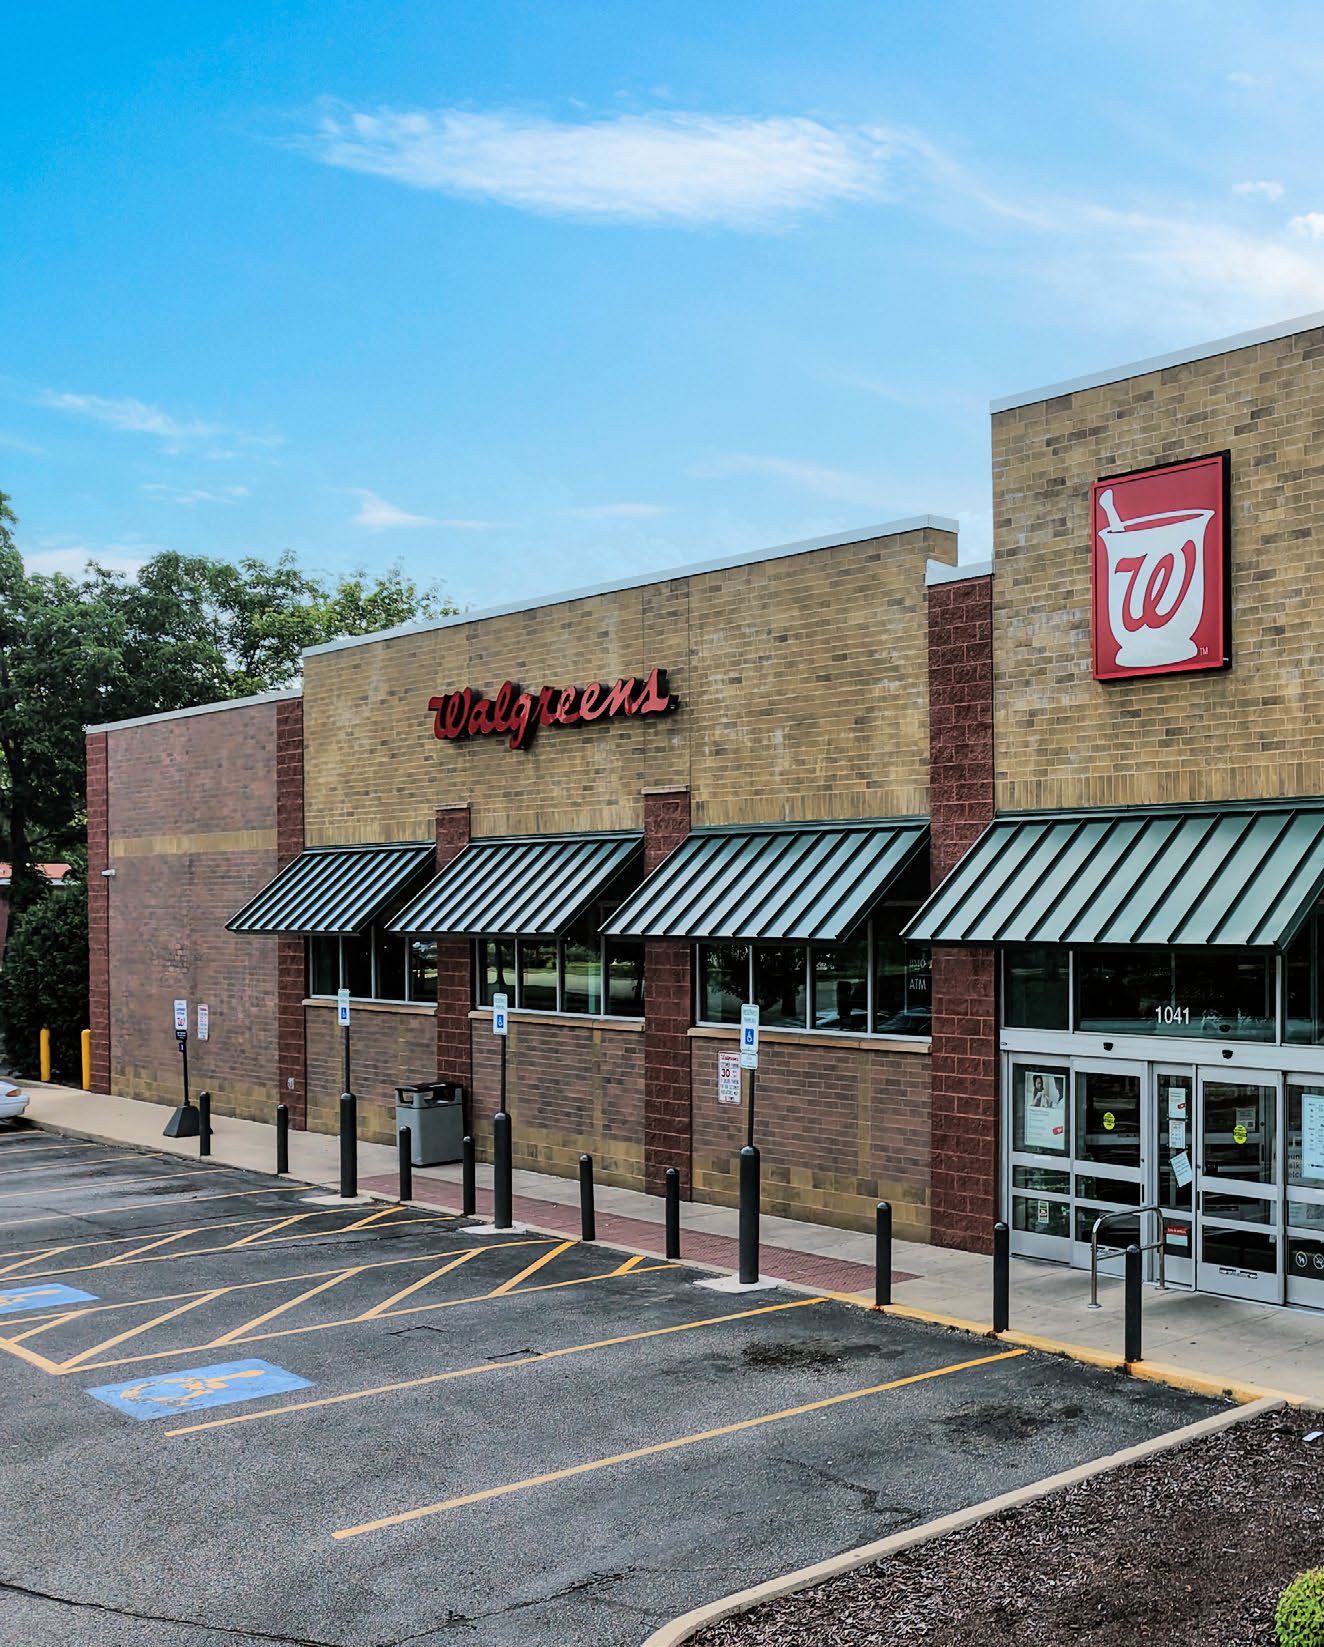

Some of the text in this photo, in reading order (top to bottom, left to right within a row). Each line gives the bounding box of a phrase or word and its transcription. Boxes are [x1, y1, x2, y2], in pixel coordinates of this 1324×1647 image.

[1114, 539, 1197, 632] W
[428, 667, 671, 749] Walgreens
[1155, 1006, 1190, 1024] 1041
[721, 1068, 731, 1078] 30
